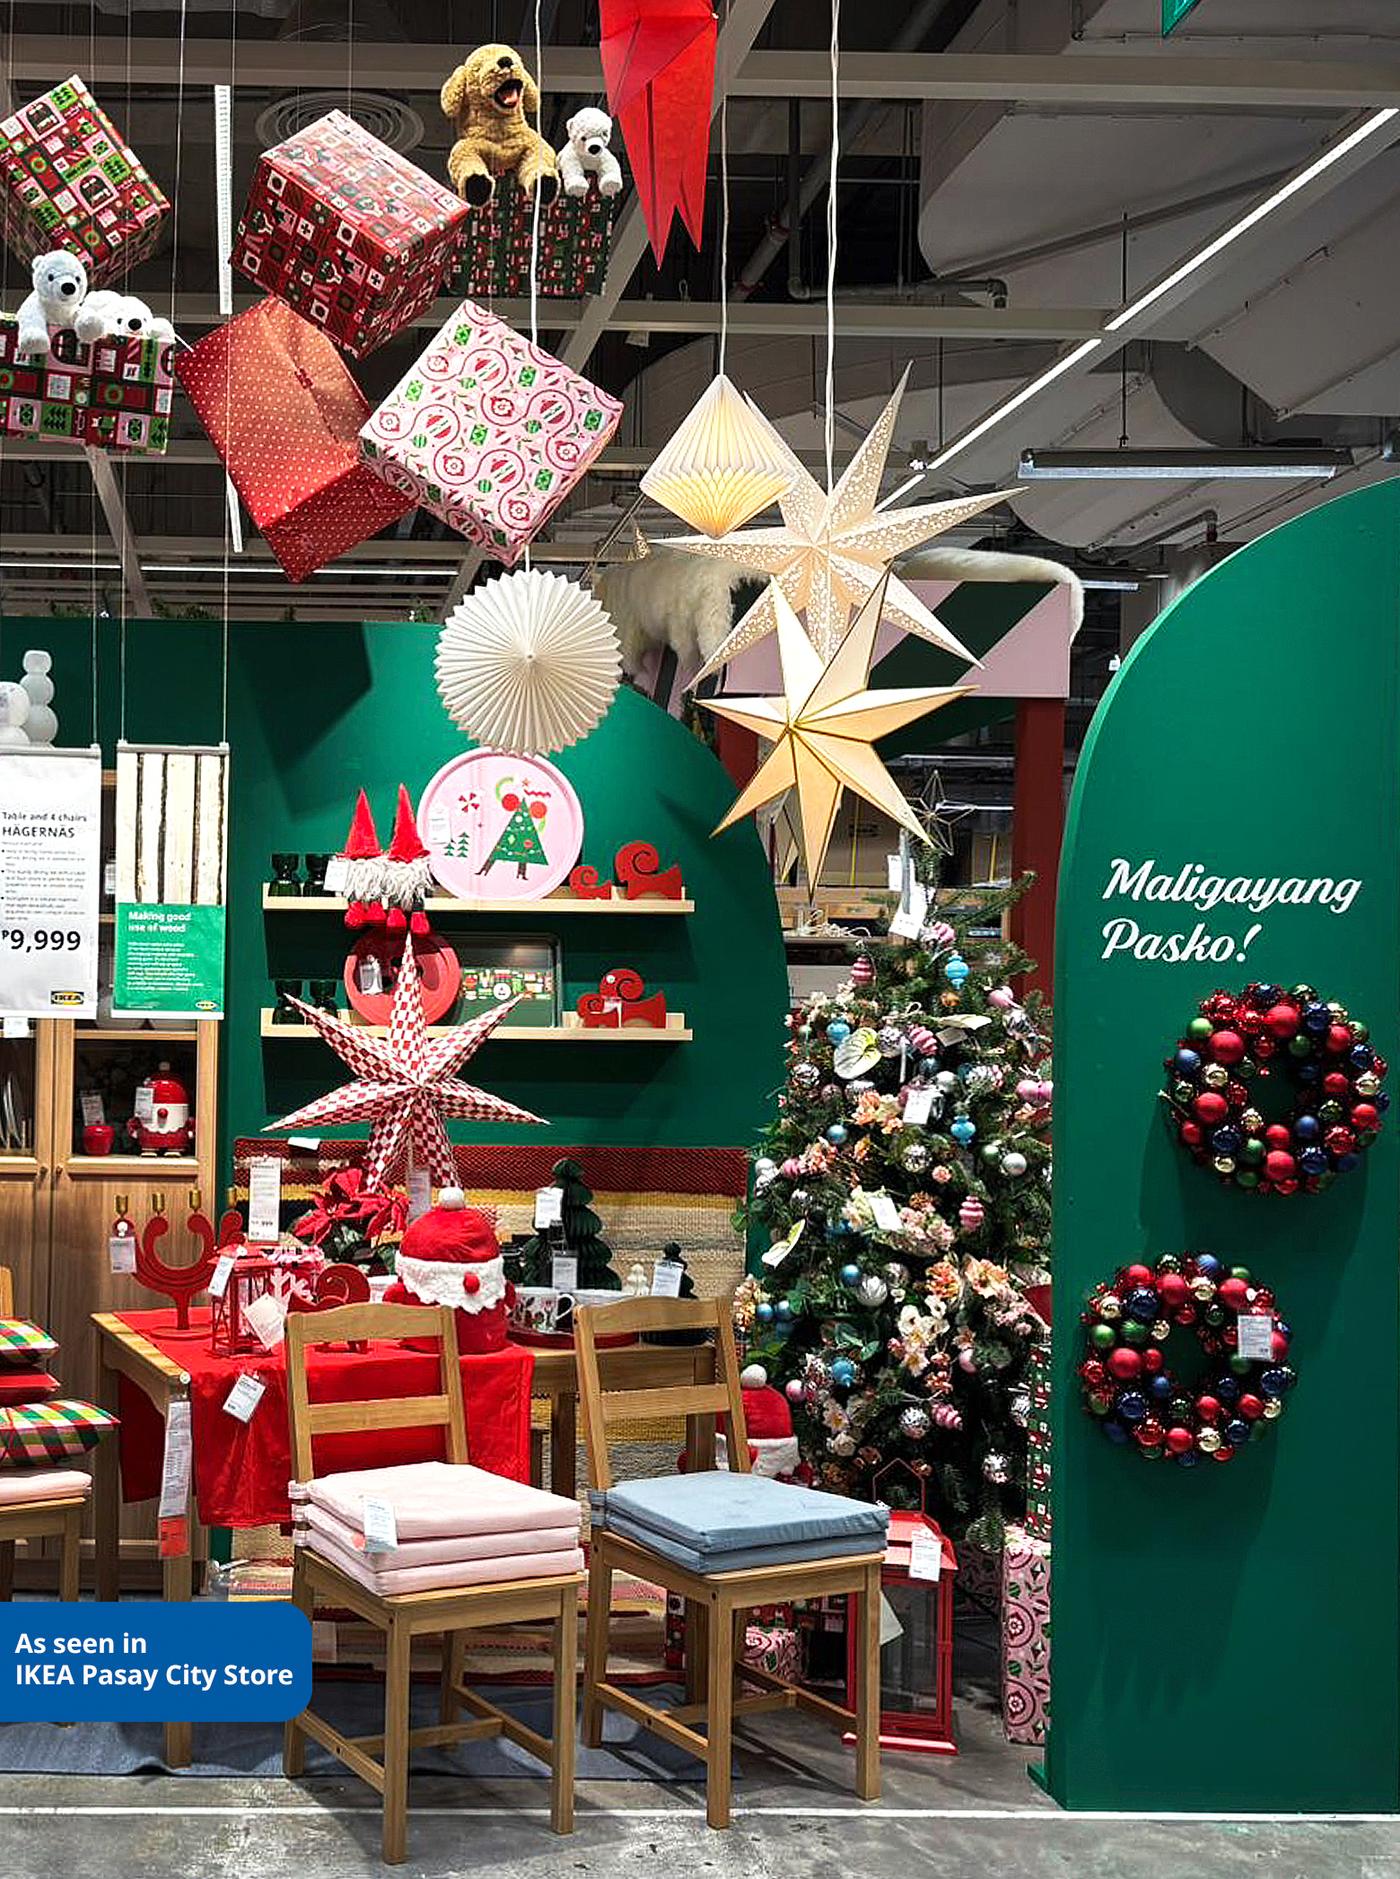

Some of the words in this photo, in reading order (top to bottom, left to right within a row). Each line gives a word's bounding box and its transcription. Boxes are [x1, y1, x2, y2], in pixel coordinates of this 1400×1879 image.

[2, 811, 26, 820] Table
[30, 812, 48, 820] and
[1102, 858, 1363, 913] Maligayang
[128, 911, 165, 922] Making
[167, 911, 191, 922] good
[1101, 917, 1263, 962] Pasko!
